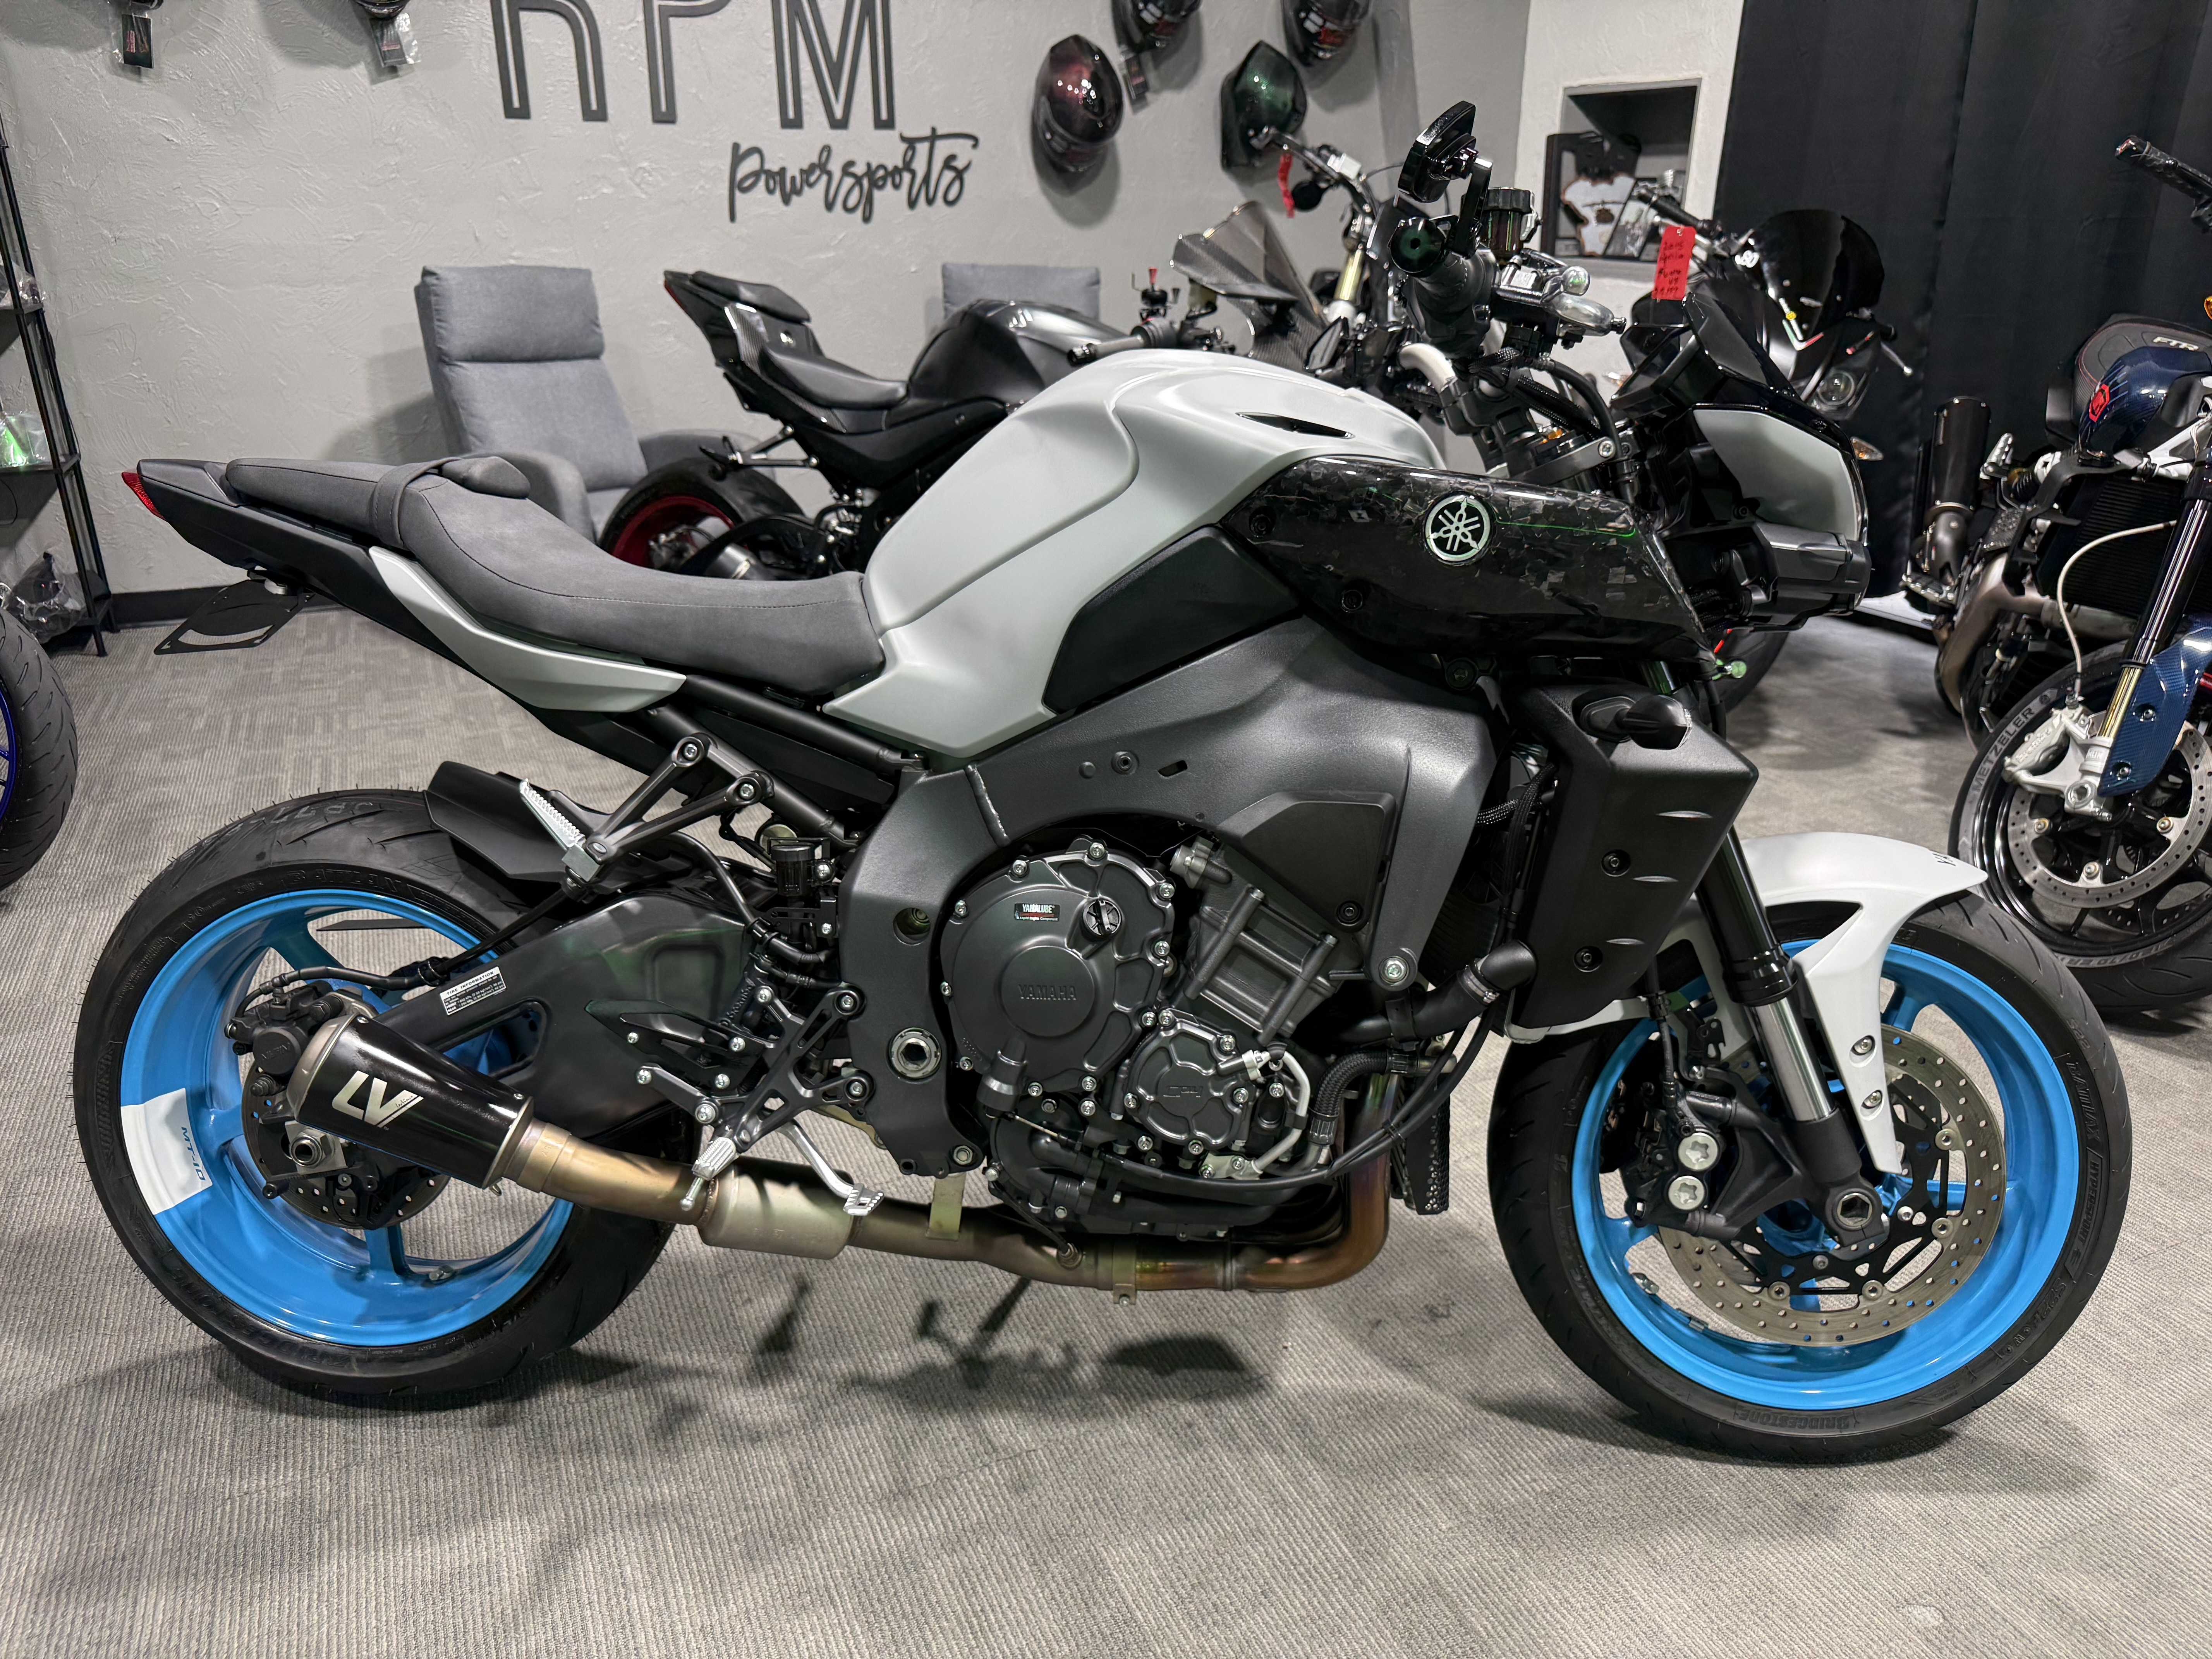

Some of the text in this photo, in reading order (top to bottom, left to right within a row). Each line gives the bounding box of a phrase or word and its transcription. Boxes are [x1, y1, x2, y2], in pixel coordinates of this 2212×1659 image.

[2153, 337, 2199, 351] FTR
[1971, 707, 2034, 793] METZELER
[460, 970, 494, 989] INFORMATION
[1018, 984, 1077, 1000] YAMAHA
[1163, 1085, 1203, 1097] CP4
[182, 1127, 206, 1181] MT-10
[2077, 1161, 2099, 1245] HYPERSPORT
[1738, 1409, 1850, 1430] BRIDGESTONE
